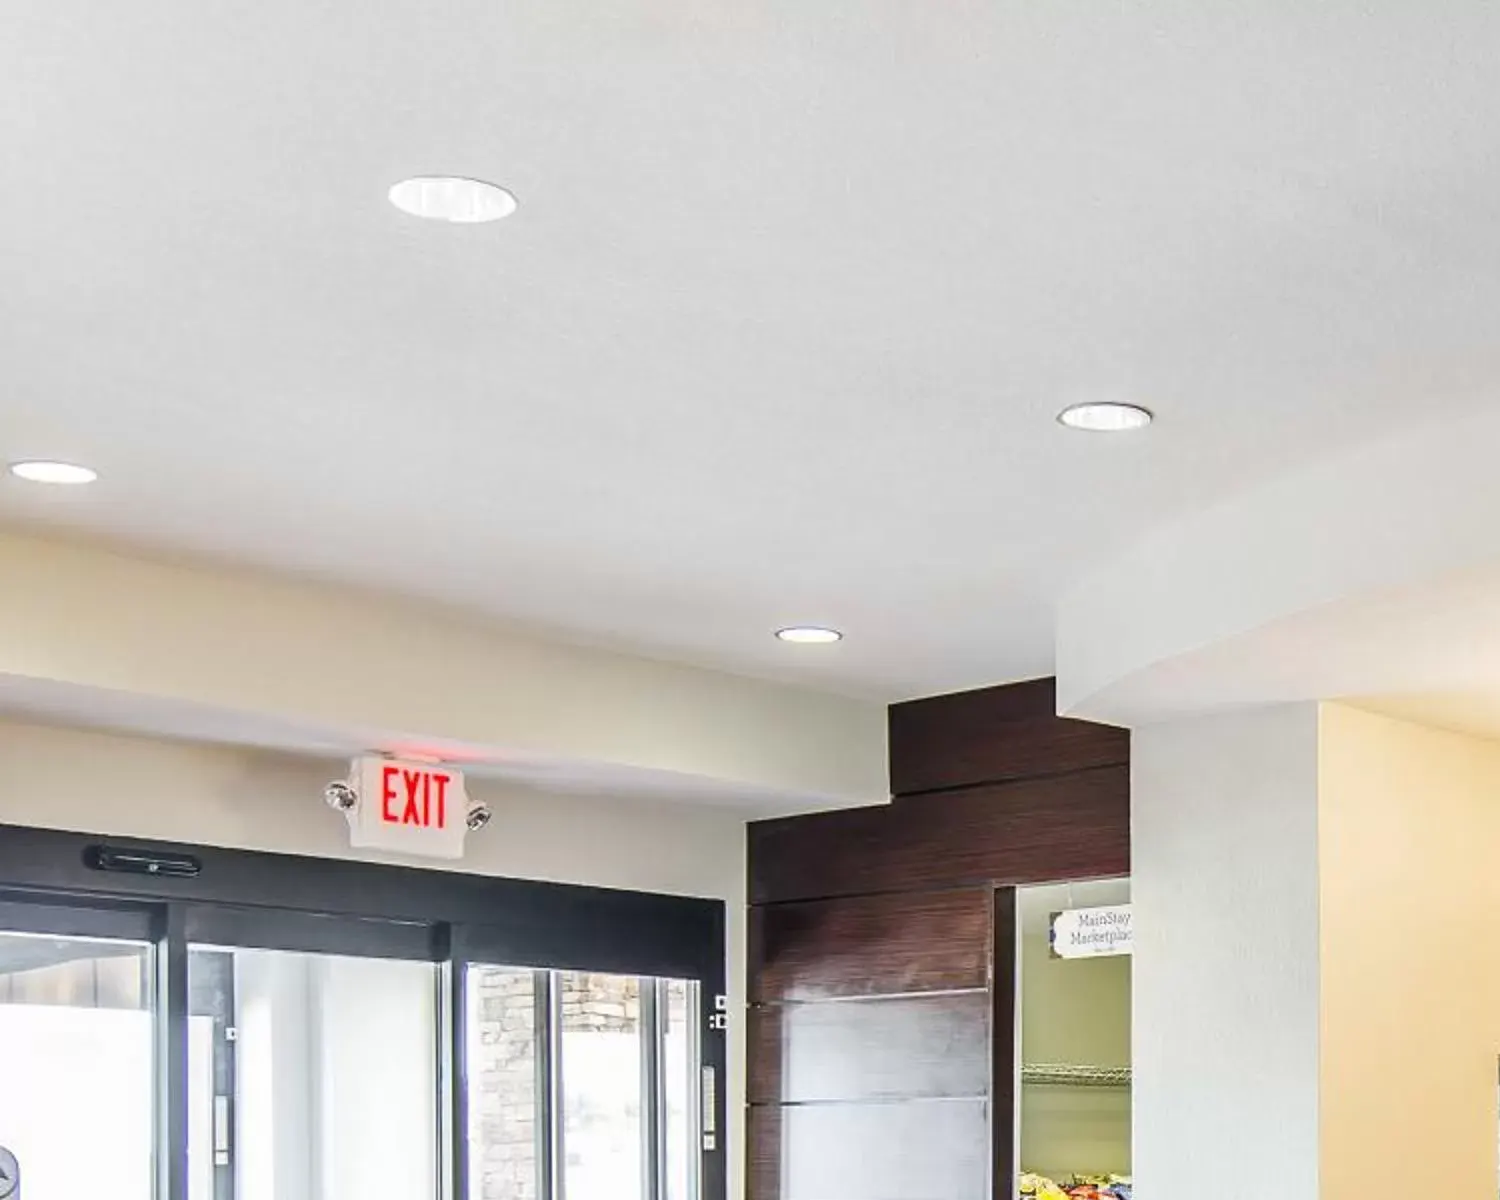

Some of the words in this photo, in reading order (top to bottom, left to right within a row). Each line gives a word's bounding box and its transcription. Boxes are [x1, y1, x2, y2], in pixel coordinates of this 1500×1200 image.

[383, 767, 450, 829] EXIT
[1079, 911, 1131, 927] MainStay
[1070, 927, 1132, 945] Marketplac
